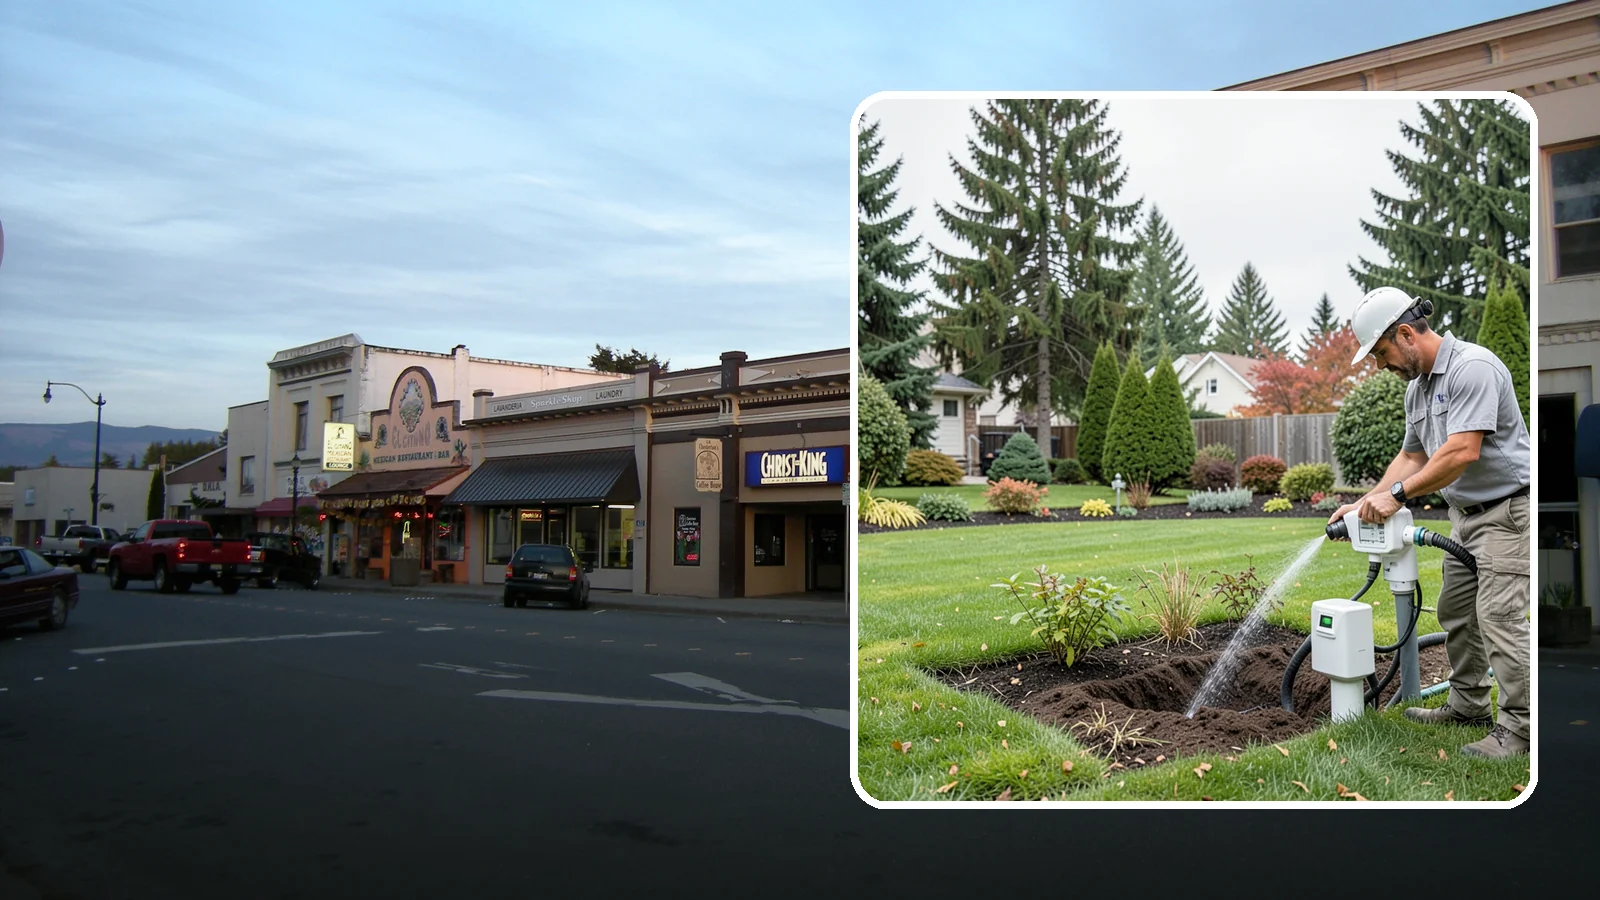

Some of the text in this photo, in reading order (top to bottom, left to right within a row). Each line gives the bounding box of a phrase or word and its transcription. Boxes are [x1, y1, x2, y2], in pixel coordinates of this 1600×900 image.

[531, 394, 583, 409] Sparkle Shop
[595, 389, 624, 400] LAUNDRY
[493, 402, 523, 413] LAVANDERIA
[373, 454, 396, 464] MEXICAN
[397, 451, 433, 462] RESTAURANT
[438, 450, 450, 459] BAR
[760, 450, 827, 478] CHRIST KING
